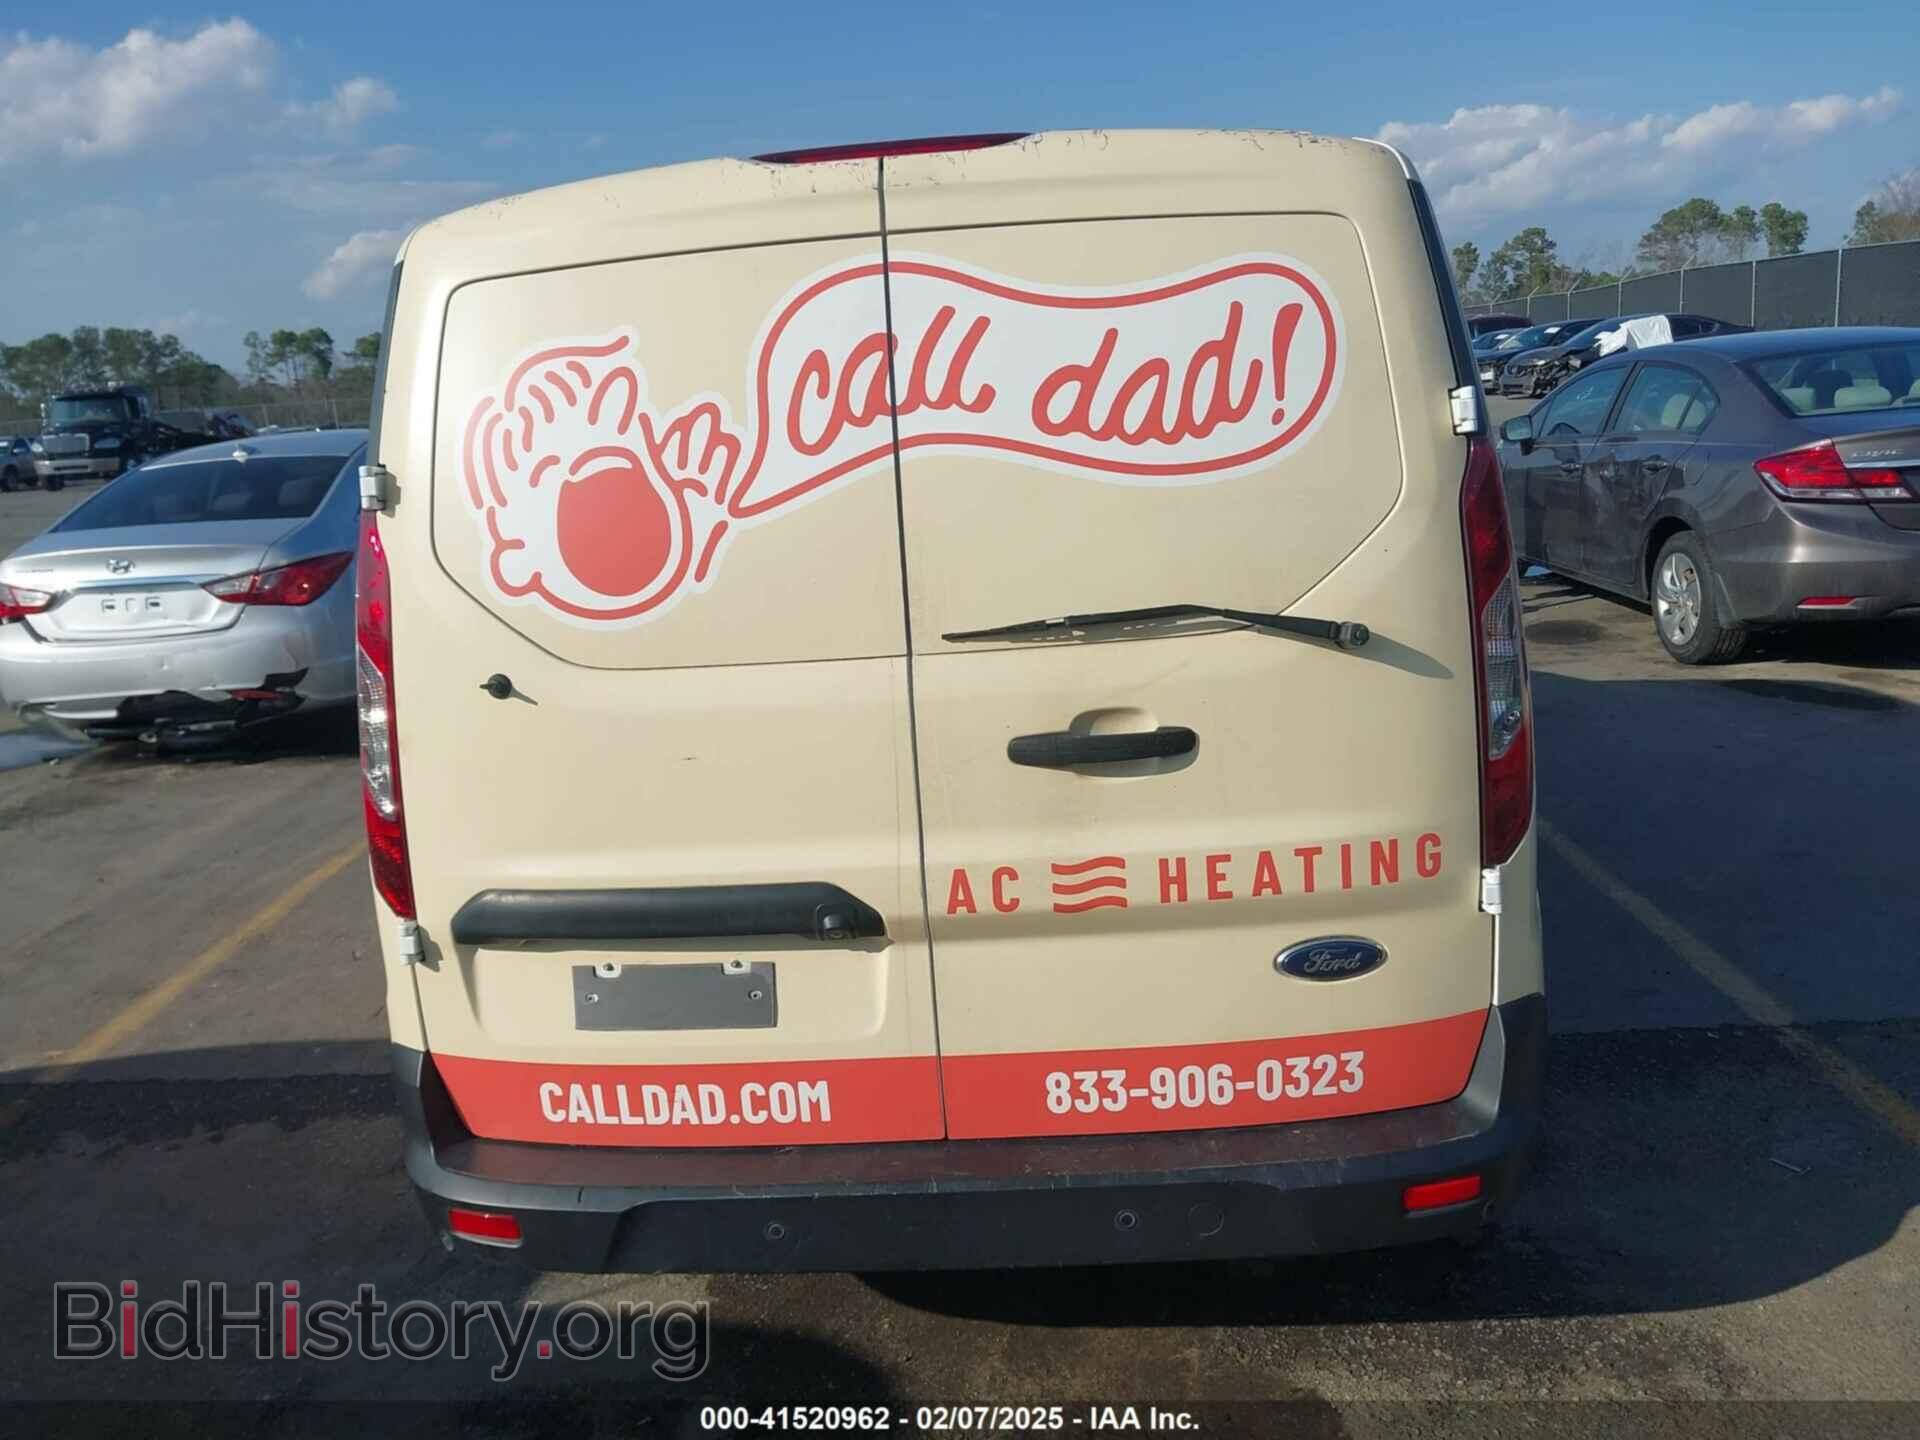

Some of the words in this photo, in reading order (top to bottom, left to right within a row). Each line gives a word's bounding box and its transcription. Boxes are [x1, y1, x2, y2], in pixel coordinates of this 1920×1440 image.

[787, 304, 996, 456] call
[1031, 300, 1303, 446] dad!
[946, 865, 1021, 915] AC
[1158, 832, 1442, 904] HEATING
[1303, 947, 1363, 973] Ford
[539, 1080, 832, 1126] CALLDAD.COM
[1045, 1050, 1366, 1114] 833-906-0323
